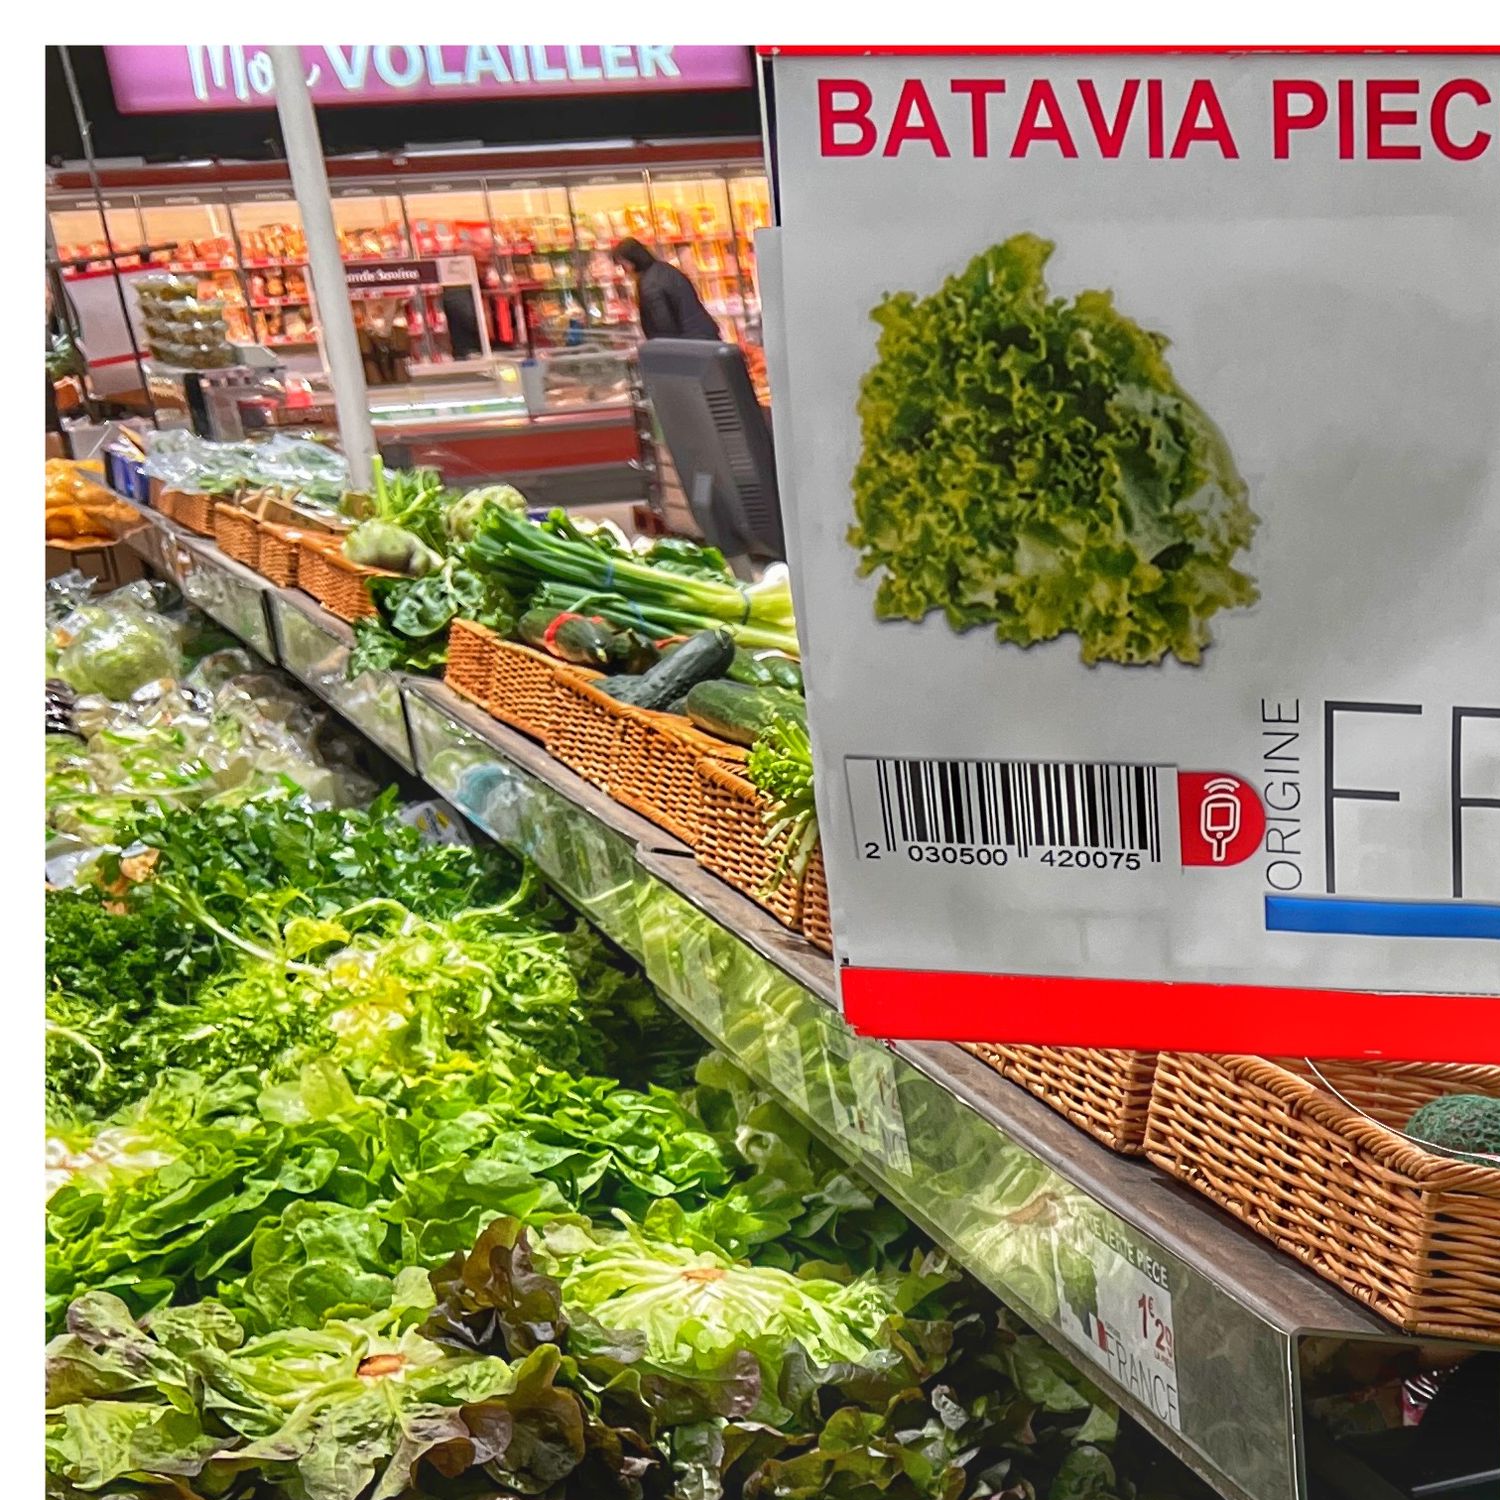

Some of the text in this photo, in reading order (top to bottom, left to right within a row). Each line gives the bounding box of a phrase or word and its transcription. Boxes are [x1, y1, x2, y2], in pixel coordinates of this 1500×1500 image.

[321, 45, 681, 89] VOLAILLER
[817, 78, 1240, 160] BATAVIA
[1261, 697, 1303, 892] ORIGINE
[864, 842, 1142, 872] 2 030500 420075
